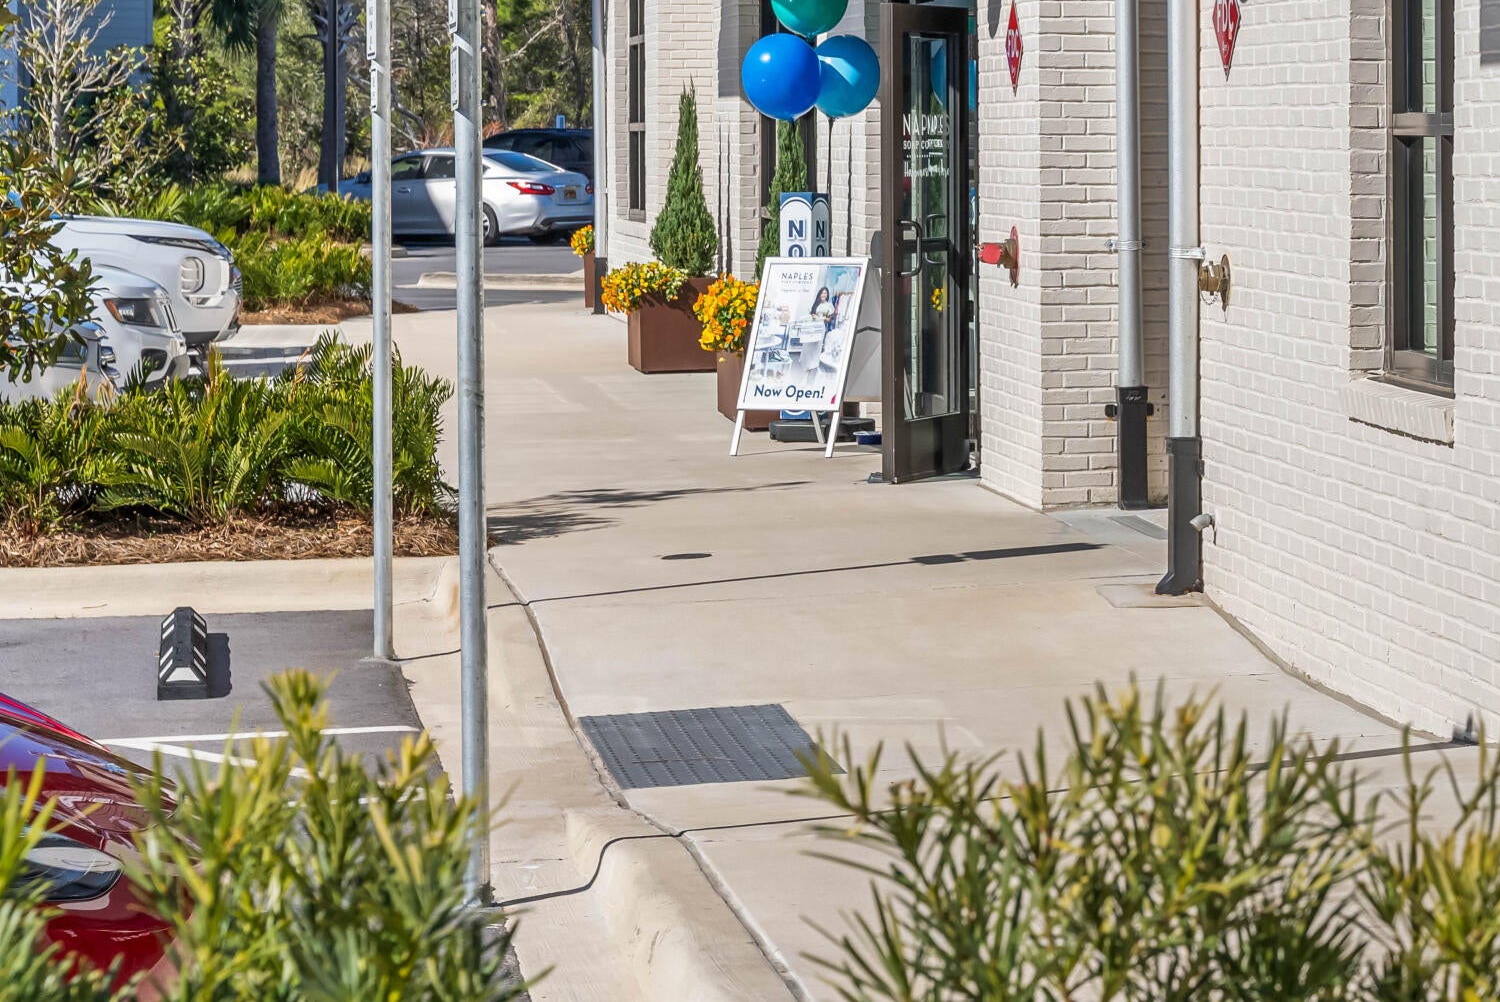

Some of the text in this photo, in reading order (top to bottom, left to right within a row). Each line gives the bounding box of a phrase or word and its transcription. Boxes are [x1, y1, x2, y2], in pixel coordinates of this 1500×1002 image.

[781, 272, 814, 281] NAPLES
[754, 384, 826, 402] Now Open!
